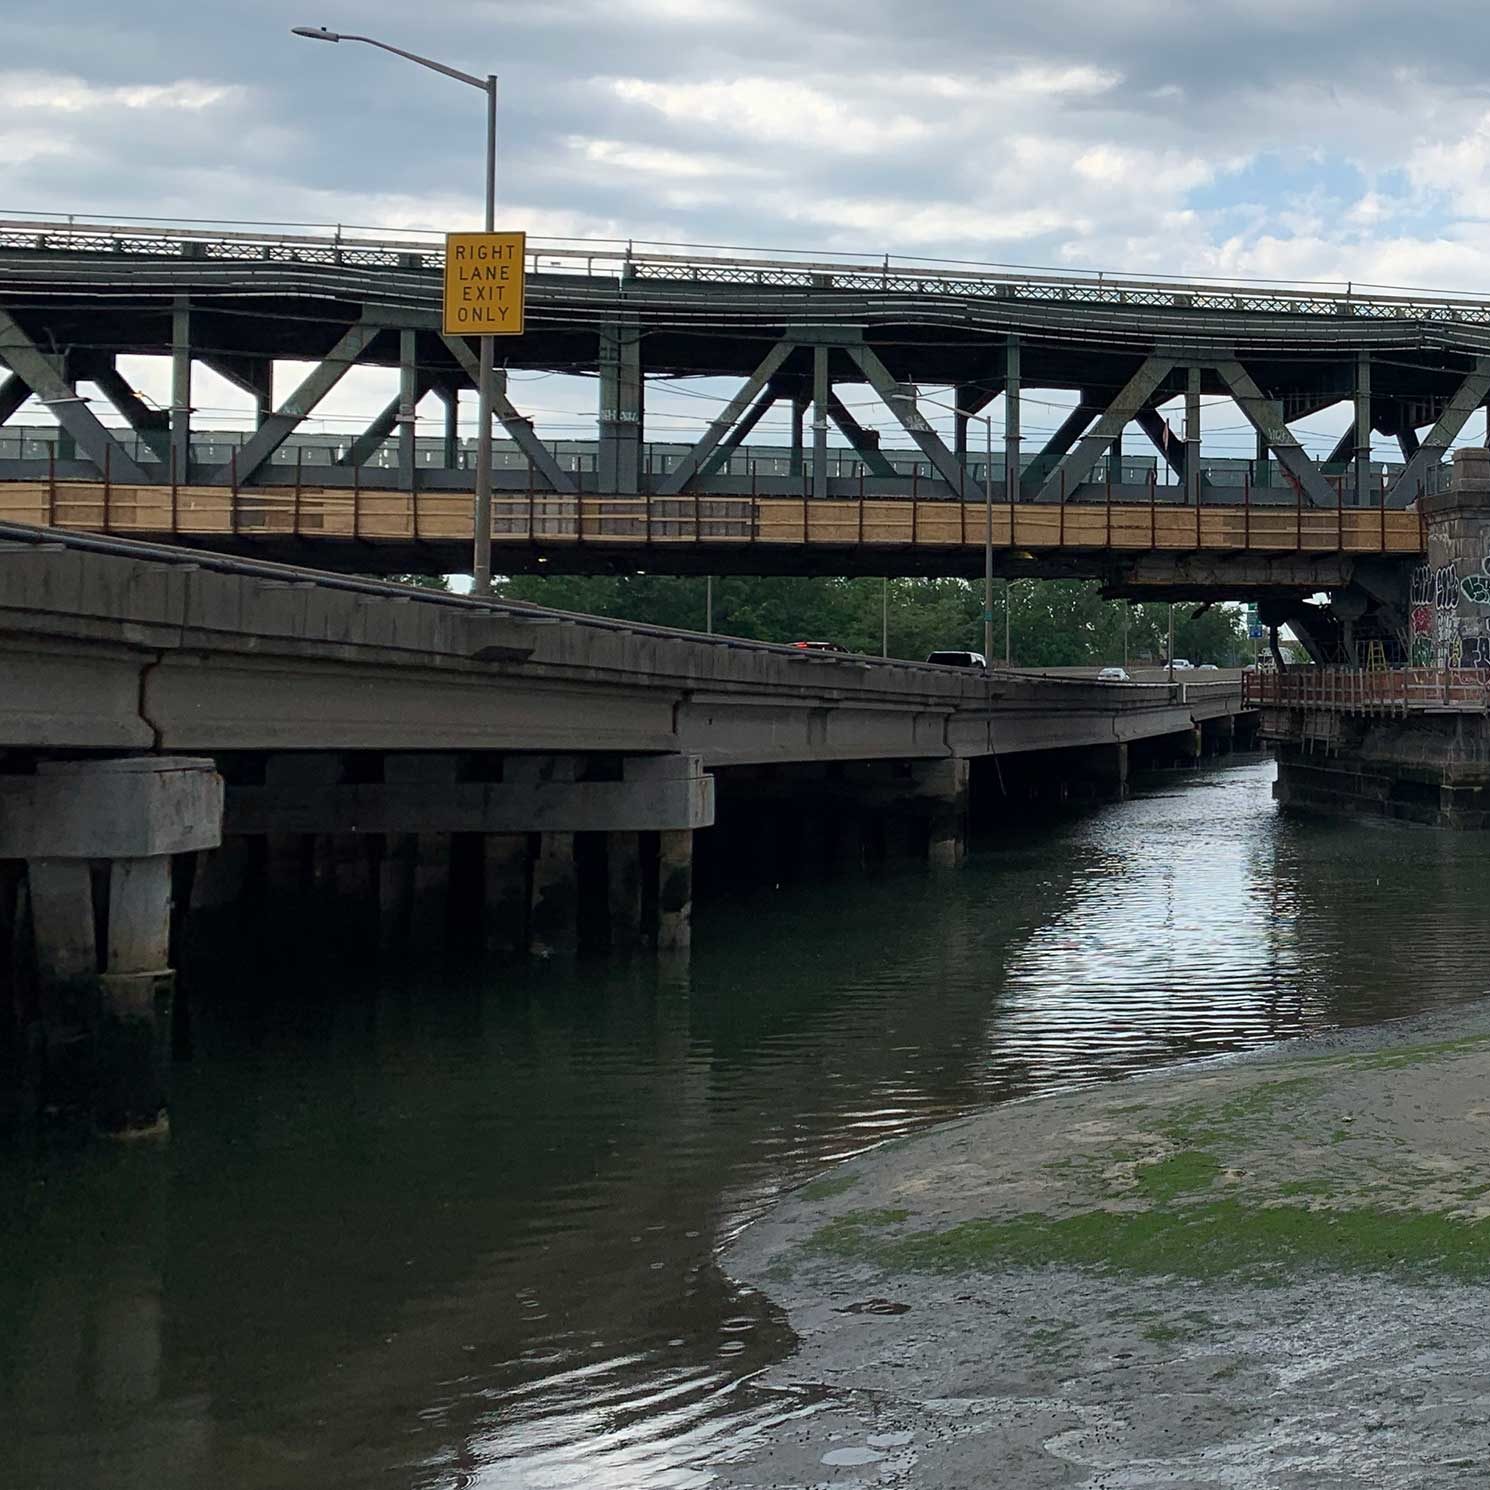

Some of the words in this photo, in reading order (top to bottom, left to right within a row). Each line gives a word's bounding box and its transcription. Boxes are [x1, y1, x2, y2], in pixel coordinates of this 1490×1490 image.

[456, 246, 514, 259] RIGHT
[460, 266, 509, 280] LANE
[463, 287, 505, 301] EXIT
[458, 307, 509, 322] ONLY
